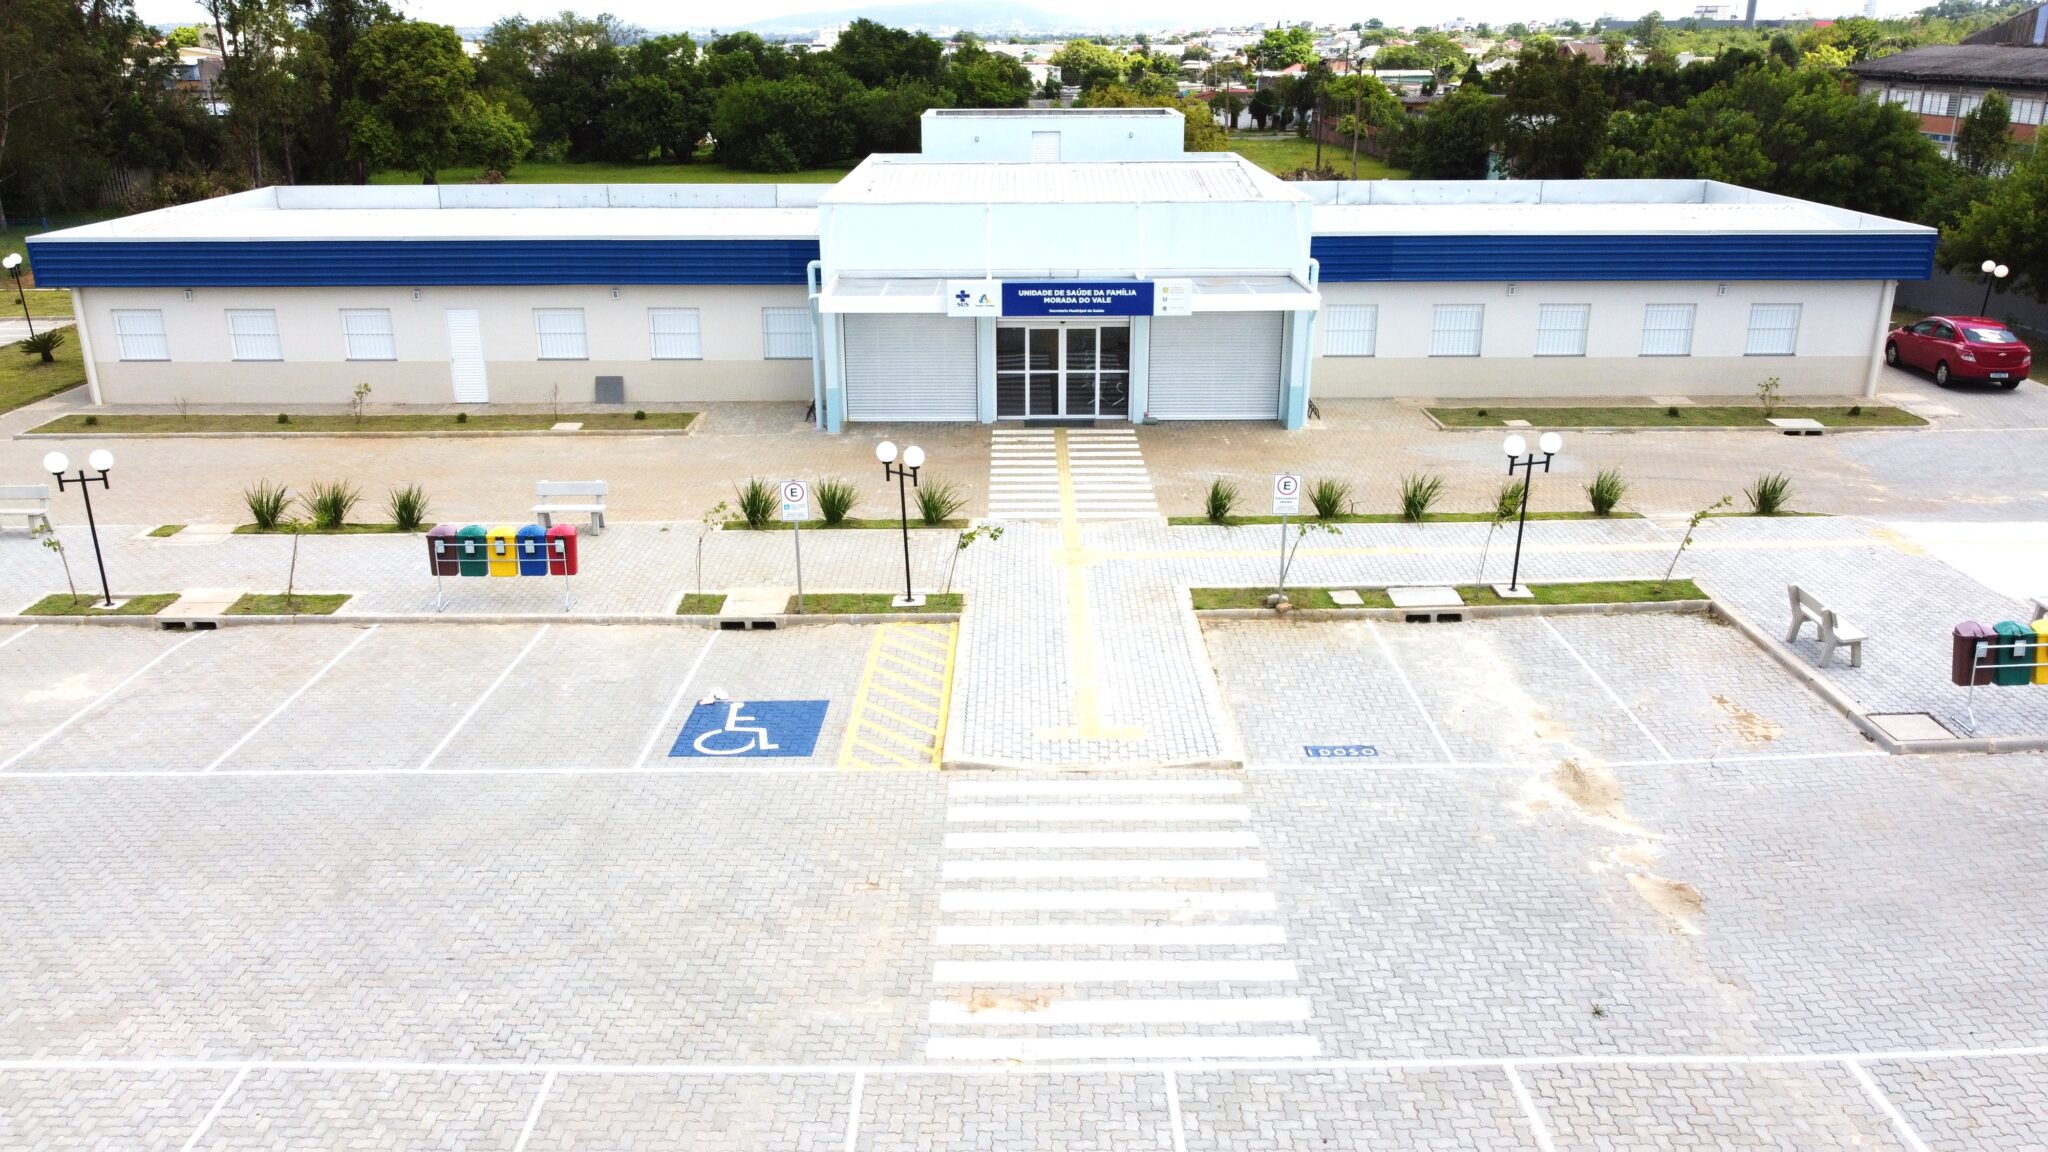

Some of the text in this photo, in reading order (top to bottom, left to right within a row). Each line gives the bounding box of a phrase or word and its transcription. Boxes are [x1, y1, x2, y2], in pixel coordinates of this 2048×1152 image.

[1066, 287, 1092, 296] SAÚDE
[1106, 287, 1137, 296] FAMÍLIA
[1283, 481, 1291, 490] E
[790, 488, 798, 497] E
